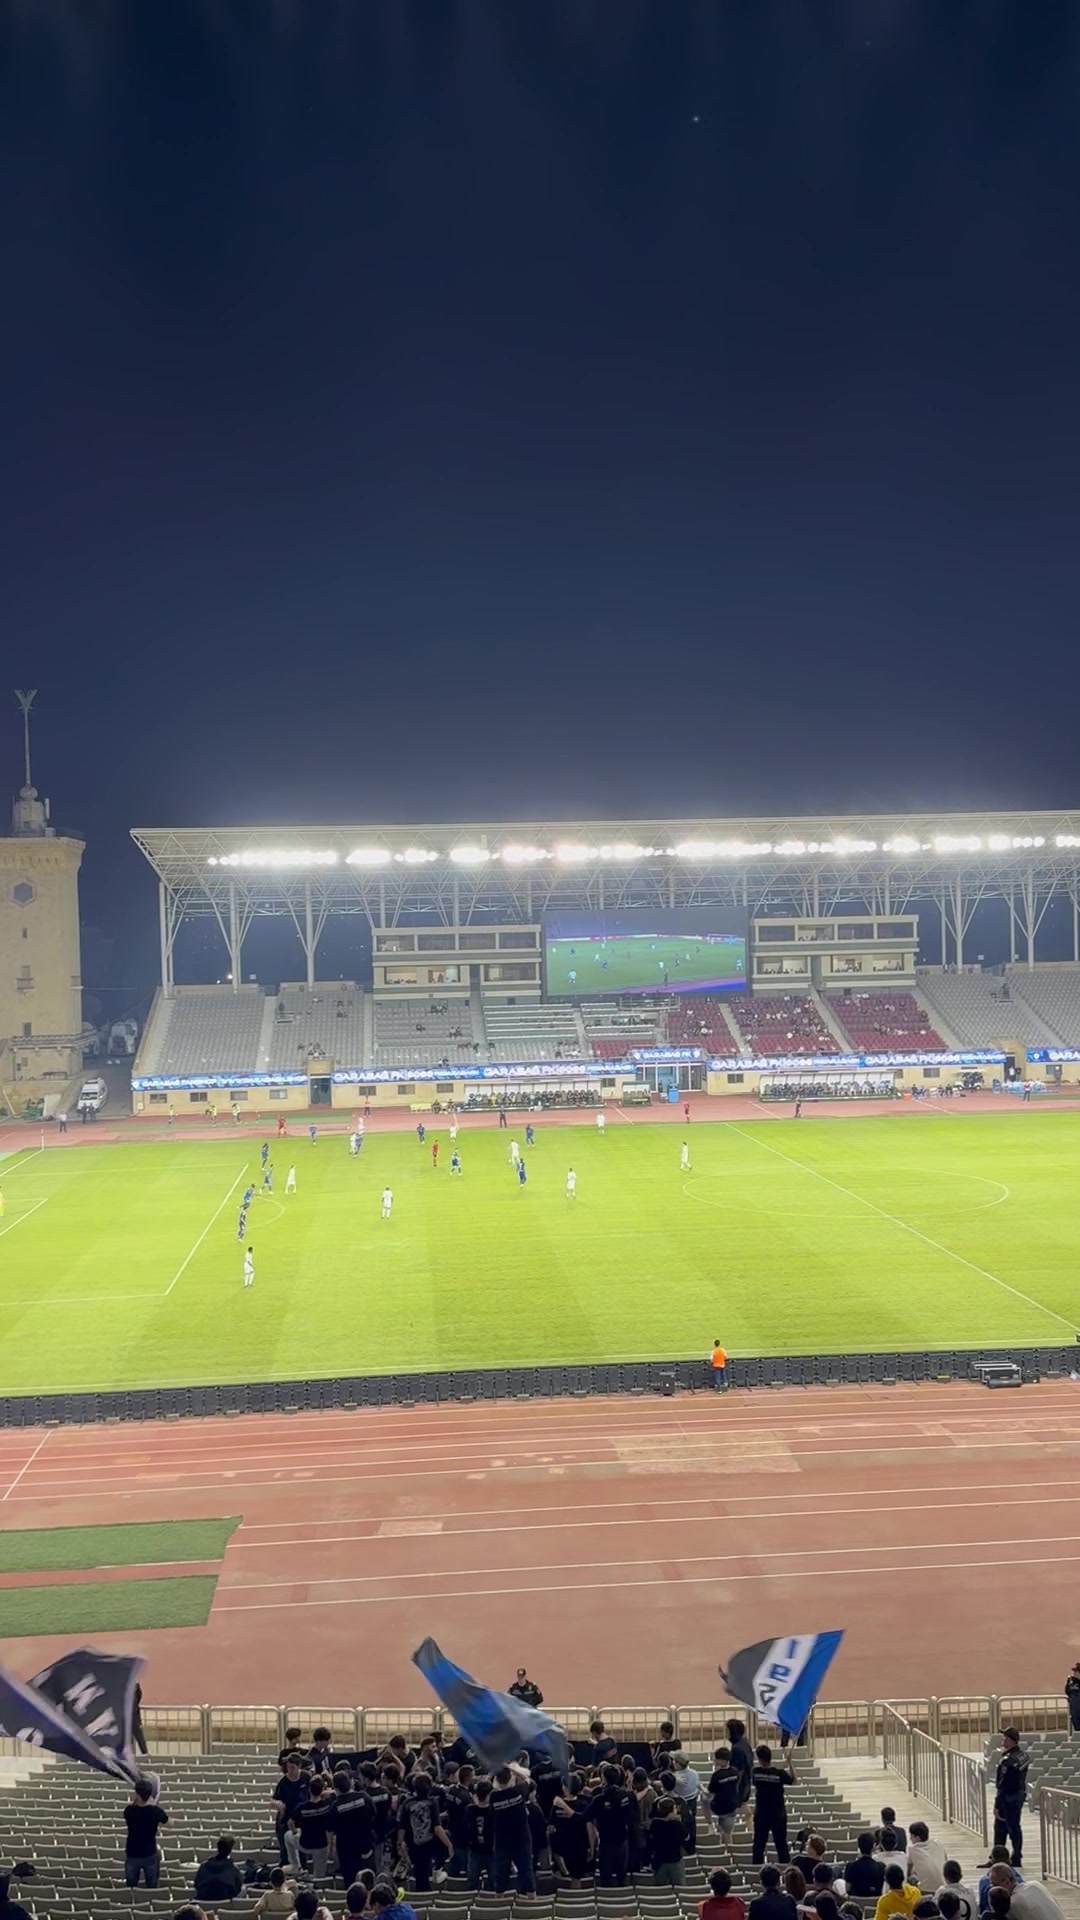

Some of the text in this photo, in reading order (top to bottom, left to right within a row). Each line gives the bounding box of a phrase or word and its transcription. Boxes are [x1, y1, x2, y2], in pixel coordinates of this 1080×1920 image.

[712, 1057, 781, 1071] QARABAĞ FK
[865, 1053, 918, 1066] QARABAĞ
[919, 1053, 931, 1065] FK
[334, 1069, 404, 1083] QARABAĞ FK
[484, 1064, 539, 1078] QARABAĞ
[541, 1064, 554, 1076] FK
